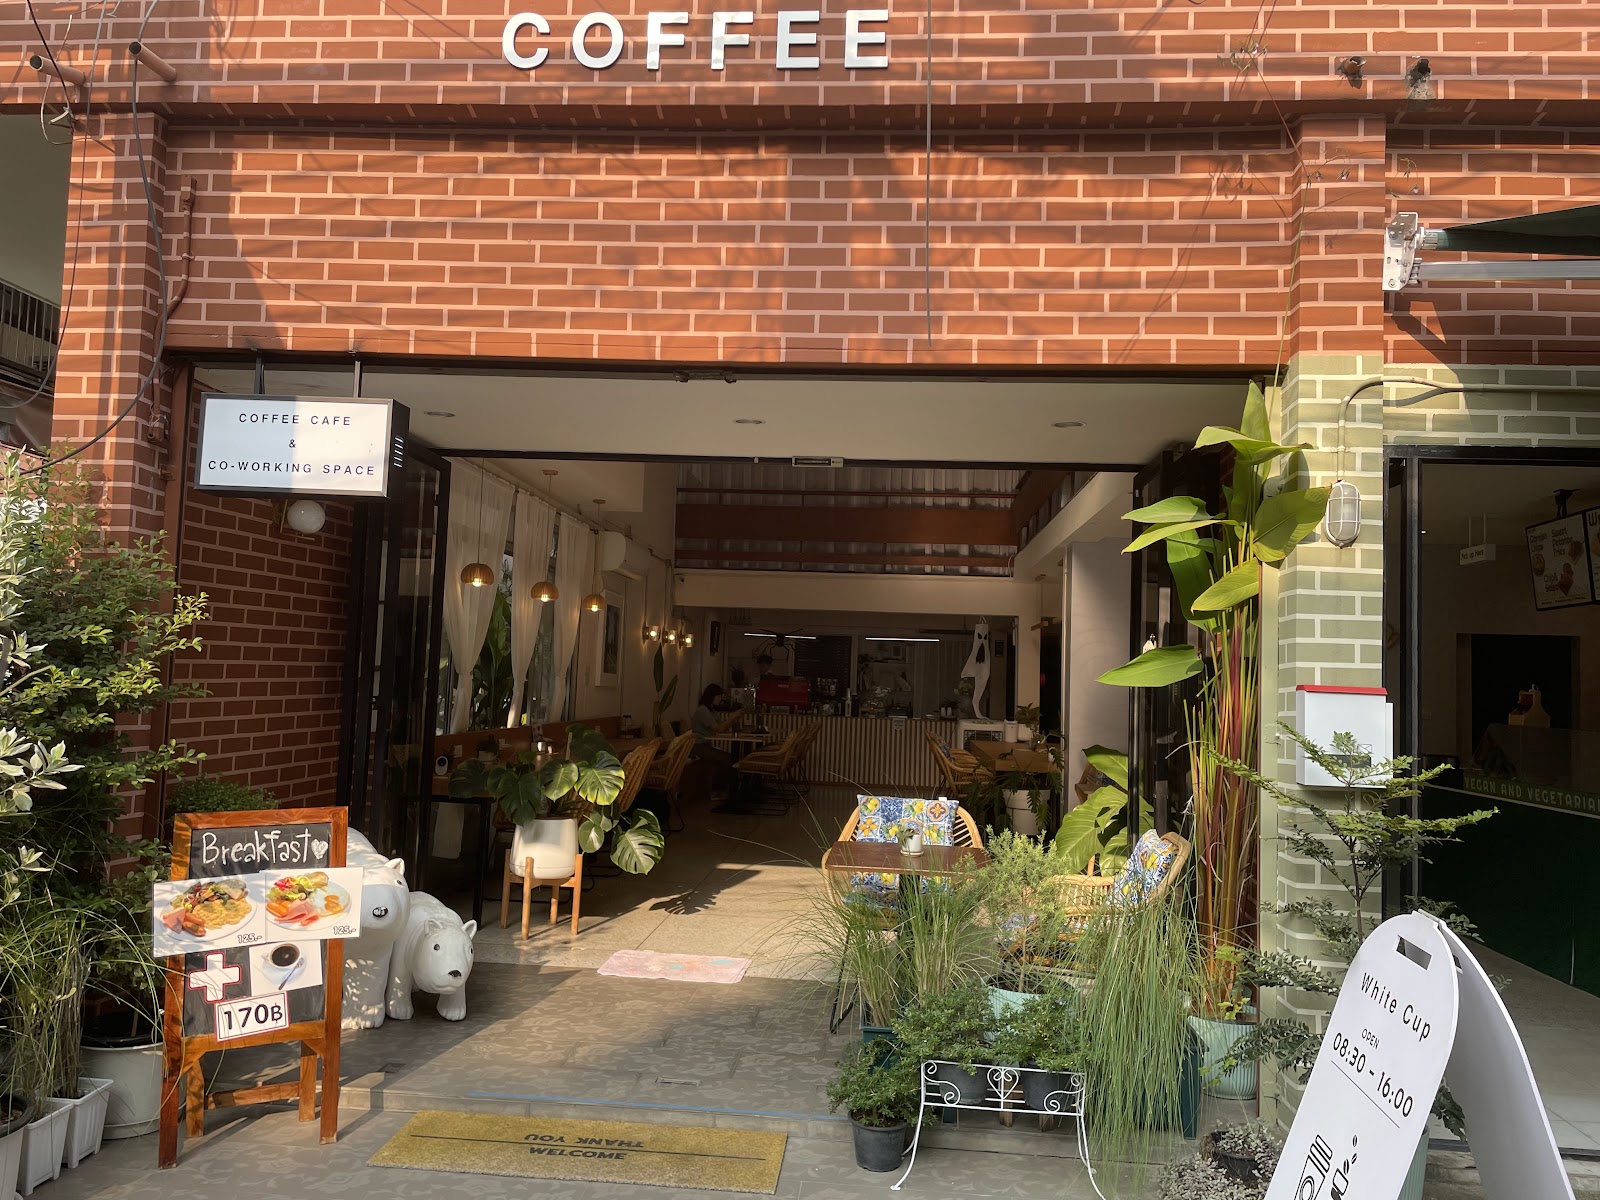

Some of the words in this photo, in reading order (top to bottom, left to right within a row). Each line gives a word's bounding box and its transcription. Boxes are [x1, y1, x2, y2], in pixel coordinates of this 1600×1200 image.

[502, 9, 889, 70] COFFEE
[239, 413, 299, 424] COFFEE
[310, 416, 351, 426] CAFE
[289, 439, 296, 448] &
[208, 461, 312, 474] CO-WORKING
[323, 465, 375, 476] SPACE
[1464, 777, 1496, 793] VEGAN
[1501, 783, 1522, 798] AND
[1527, 787, 1600, 813] VEGETARIA
[202, 828, 312, 865] Breakfast
[1361, 972, 1397, 1013] White
[1402, 1004, 1431, 1042] Cup
[1361, 1028, 1380, 1049] OPEN
[1333, 1032, 1366, 1073] 08:30
[1377, 1071, 1413, 1117] 16:00
[524, 1134, 565, 1143] YOU
[576, 1137, 644, 1147] THANK
[529, 1147, 628, 1160] WELCOME
